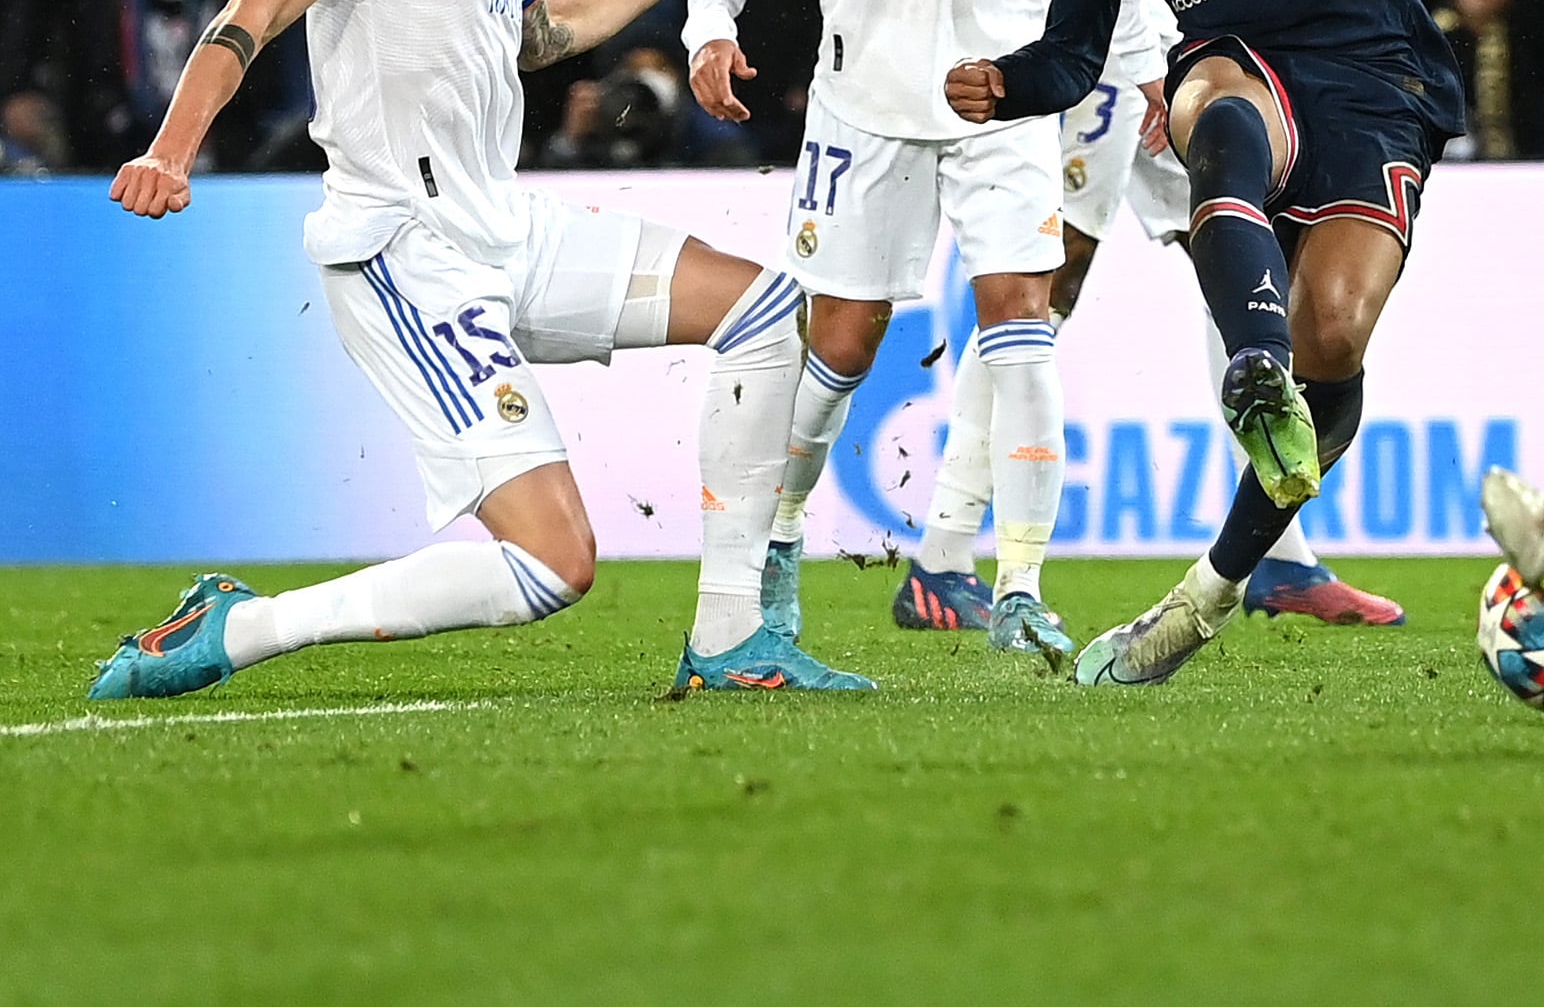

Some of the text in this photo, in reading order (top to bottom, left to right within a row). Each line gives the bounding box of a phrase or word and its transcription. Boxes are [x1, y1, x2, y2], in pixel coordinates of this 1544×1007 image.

[1077, 83, 1117, 144] 3
[799, 141, 852, 216] 17
[432, 305, 521, 387] 15
[1050, 419, 1518, 541] GAZROM
